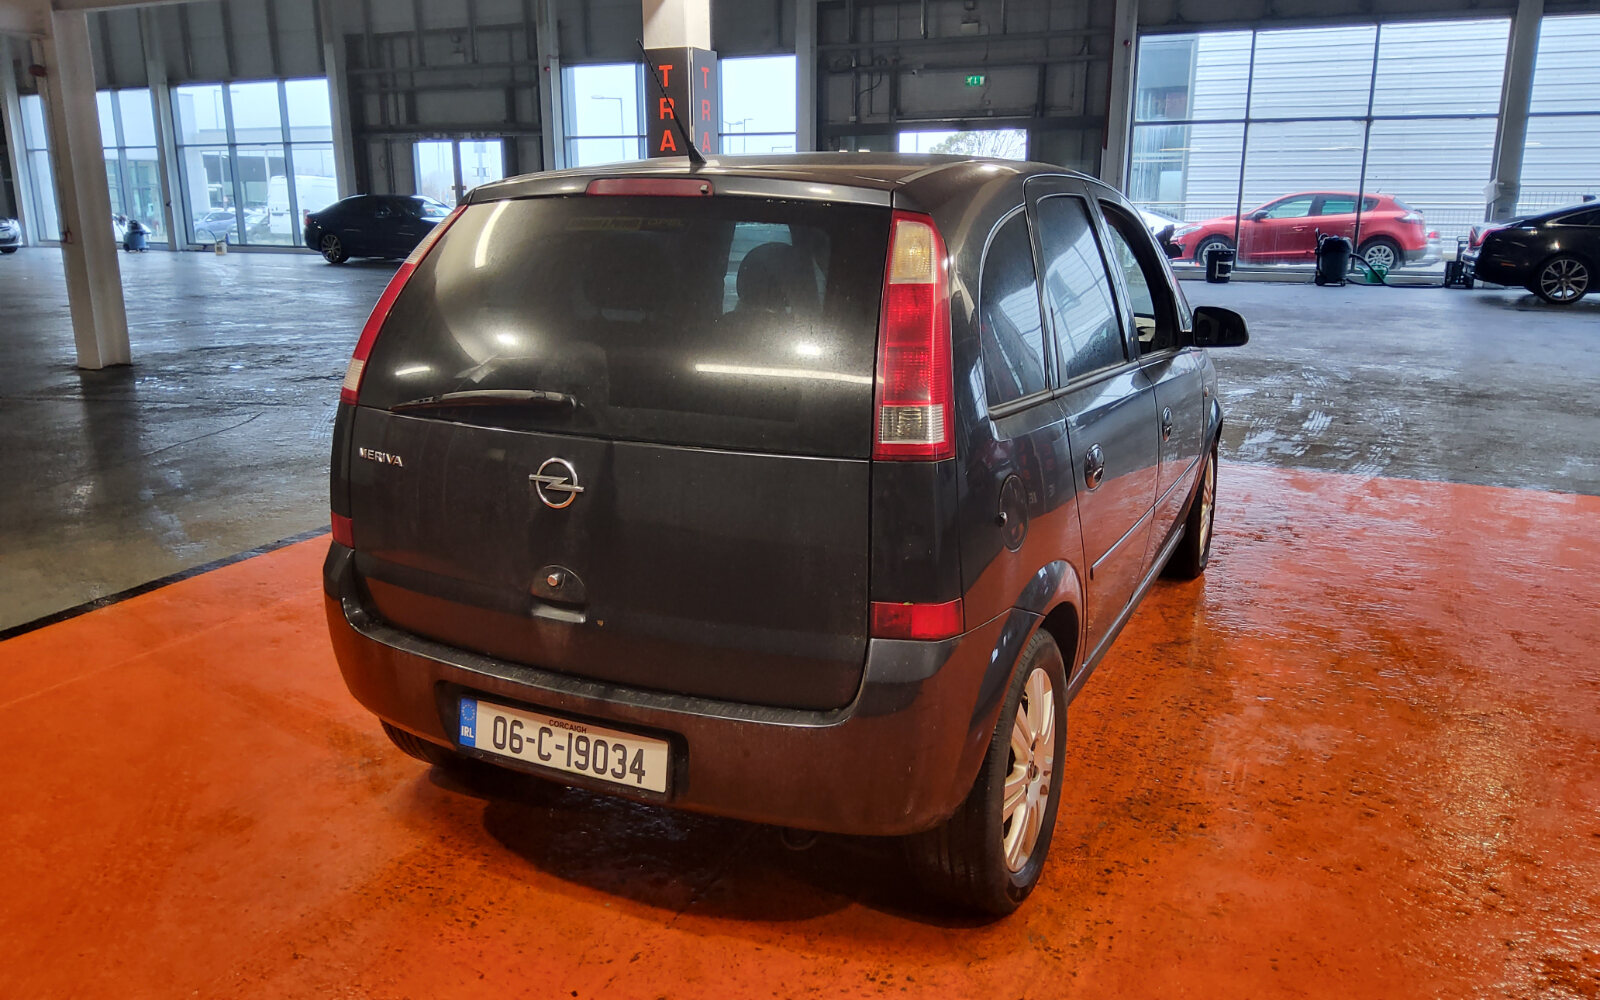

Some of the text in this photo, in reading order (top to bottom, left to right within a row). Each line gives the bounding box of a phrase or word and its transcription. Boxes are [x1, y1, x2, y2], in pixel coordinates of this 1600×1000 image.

[359, 447, 403, 467] MERIVA
[461, 725, 474, 739] IRL
[548, 719, 587, 734] CORCAIGH
[492, 715, 646, 784] 06-C-19034
